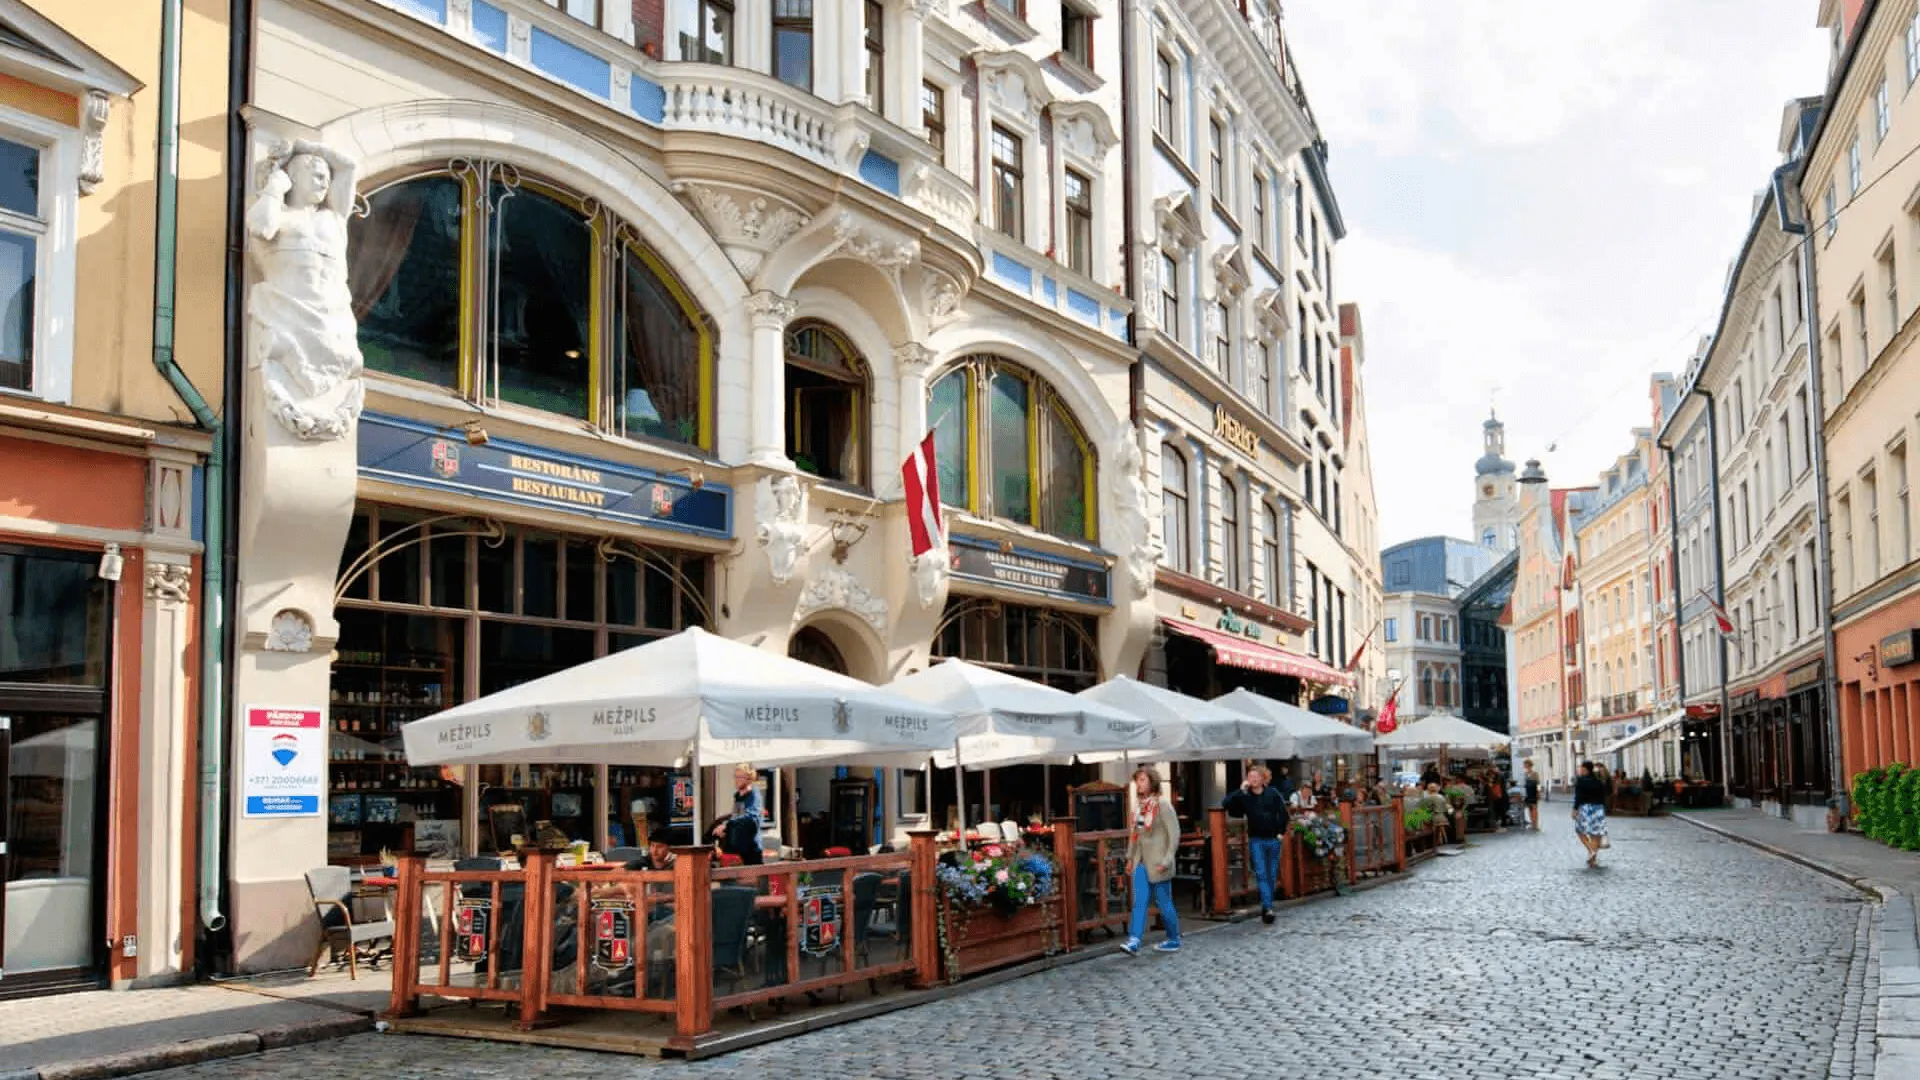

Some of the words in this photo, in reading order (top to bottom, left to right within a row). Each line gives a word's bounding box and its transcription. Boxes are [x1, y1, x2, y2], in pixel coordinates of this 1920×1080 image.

[511, 455, 600, 484] RESTORĀNS
[512, 476, 605, 506] RESTAURANT
[592, 706, 656, 725] MEŽPILS
[744, 704, 800, 722] MEŽPILS
[884, 714, 928, 732] MEŽPILS
[438, 724, 491, 744] MEŽPILS
